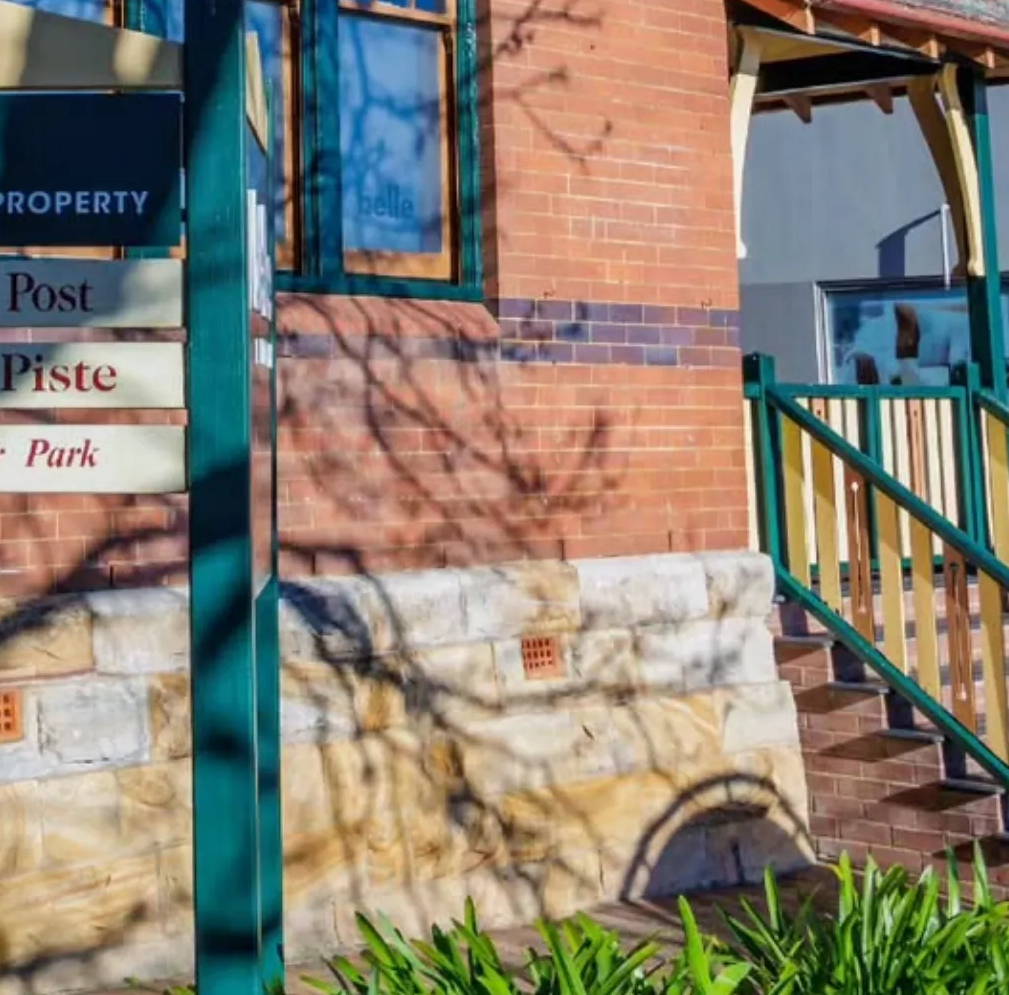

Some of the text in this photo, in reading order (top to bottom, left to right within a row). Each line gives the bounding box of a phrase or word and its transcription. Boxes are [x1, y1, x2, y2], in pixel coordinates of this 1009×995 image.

[7, 272, 94, 313] Post
[1, 353, 118, 393] Piste
[25, 438, 99, 468] Park
